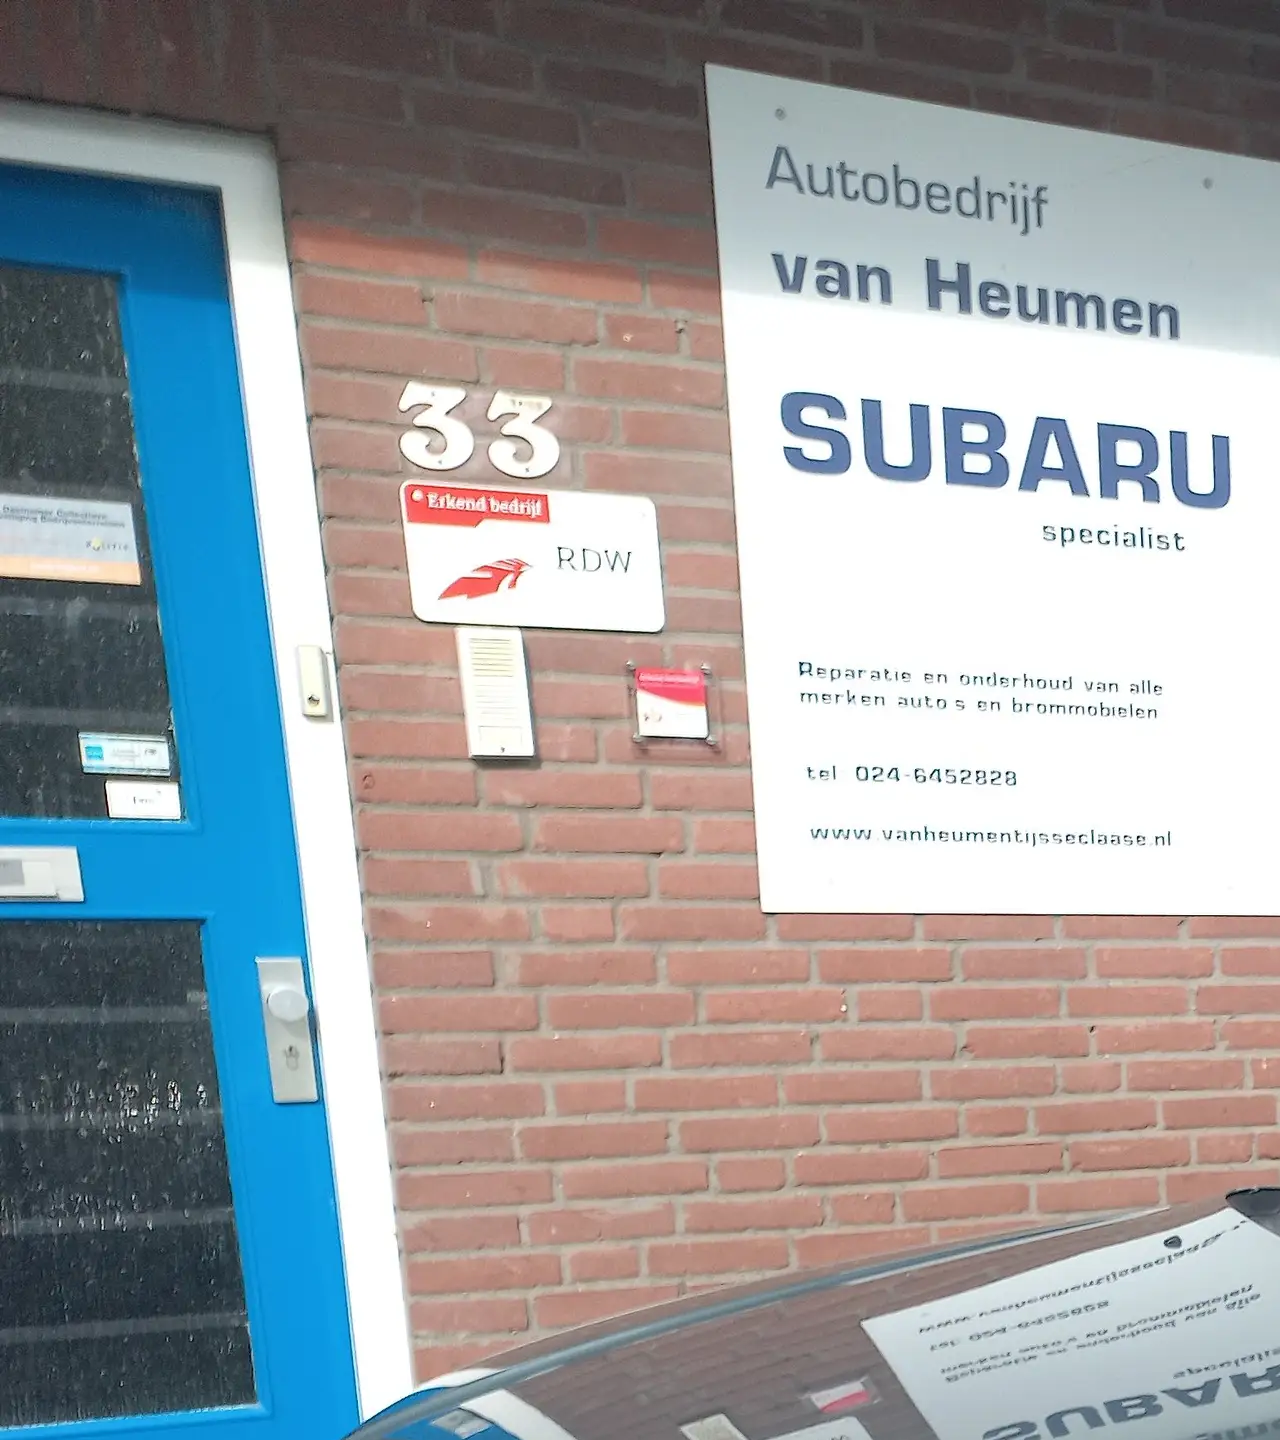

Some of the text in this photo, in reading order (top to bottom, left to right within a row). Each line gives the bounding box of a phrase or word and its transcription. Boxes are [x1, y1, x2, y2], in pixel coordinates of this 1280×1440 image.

[765, 145, 1049, 235] Autobedrijf
[771, 252, 1180, 340] van Heumen
[399, 381, 560, 479] 33
[780, 391, 1231, 509] SUBARU
[427, 492, 542, 518] Erkend bedrijf
[1042, 521, 1186, 551] specialist
[557, 546, 632, 573] RDW
[799, 661, 1163, 696] Reparatie en onderhoud van alle
[800, 690, 885, 706] merken
[977, 700, 1001, 712] en
[1012, 698, 1158, 719] brommobielen
[856, 765, 1017, 786] 024-6452828
[810, 825, 1171, 848] www.vanheumentijsseclaase.nl
